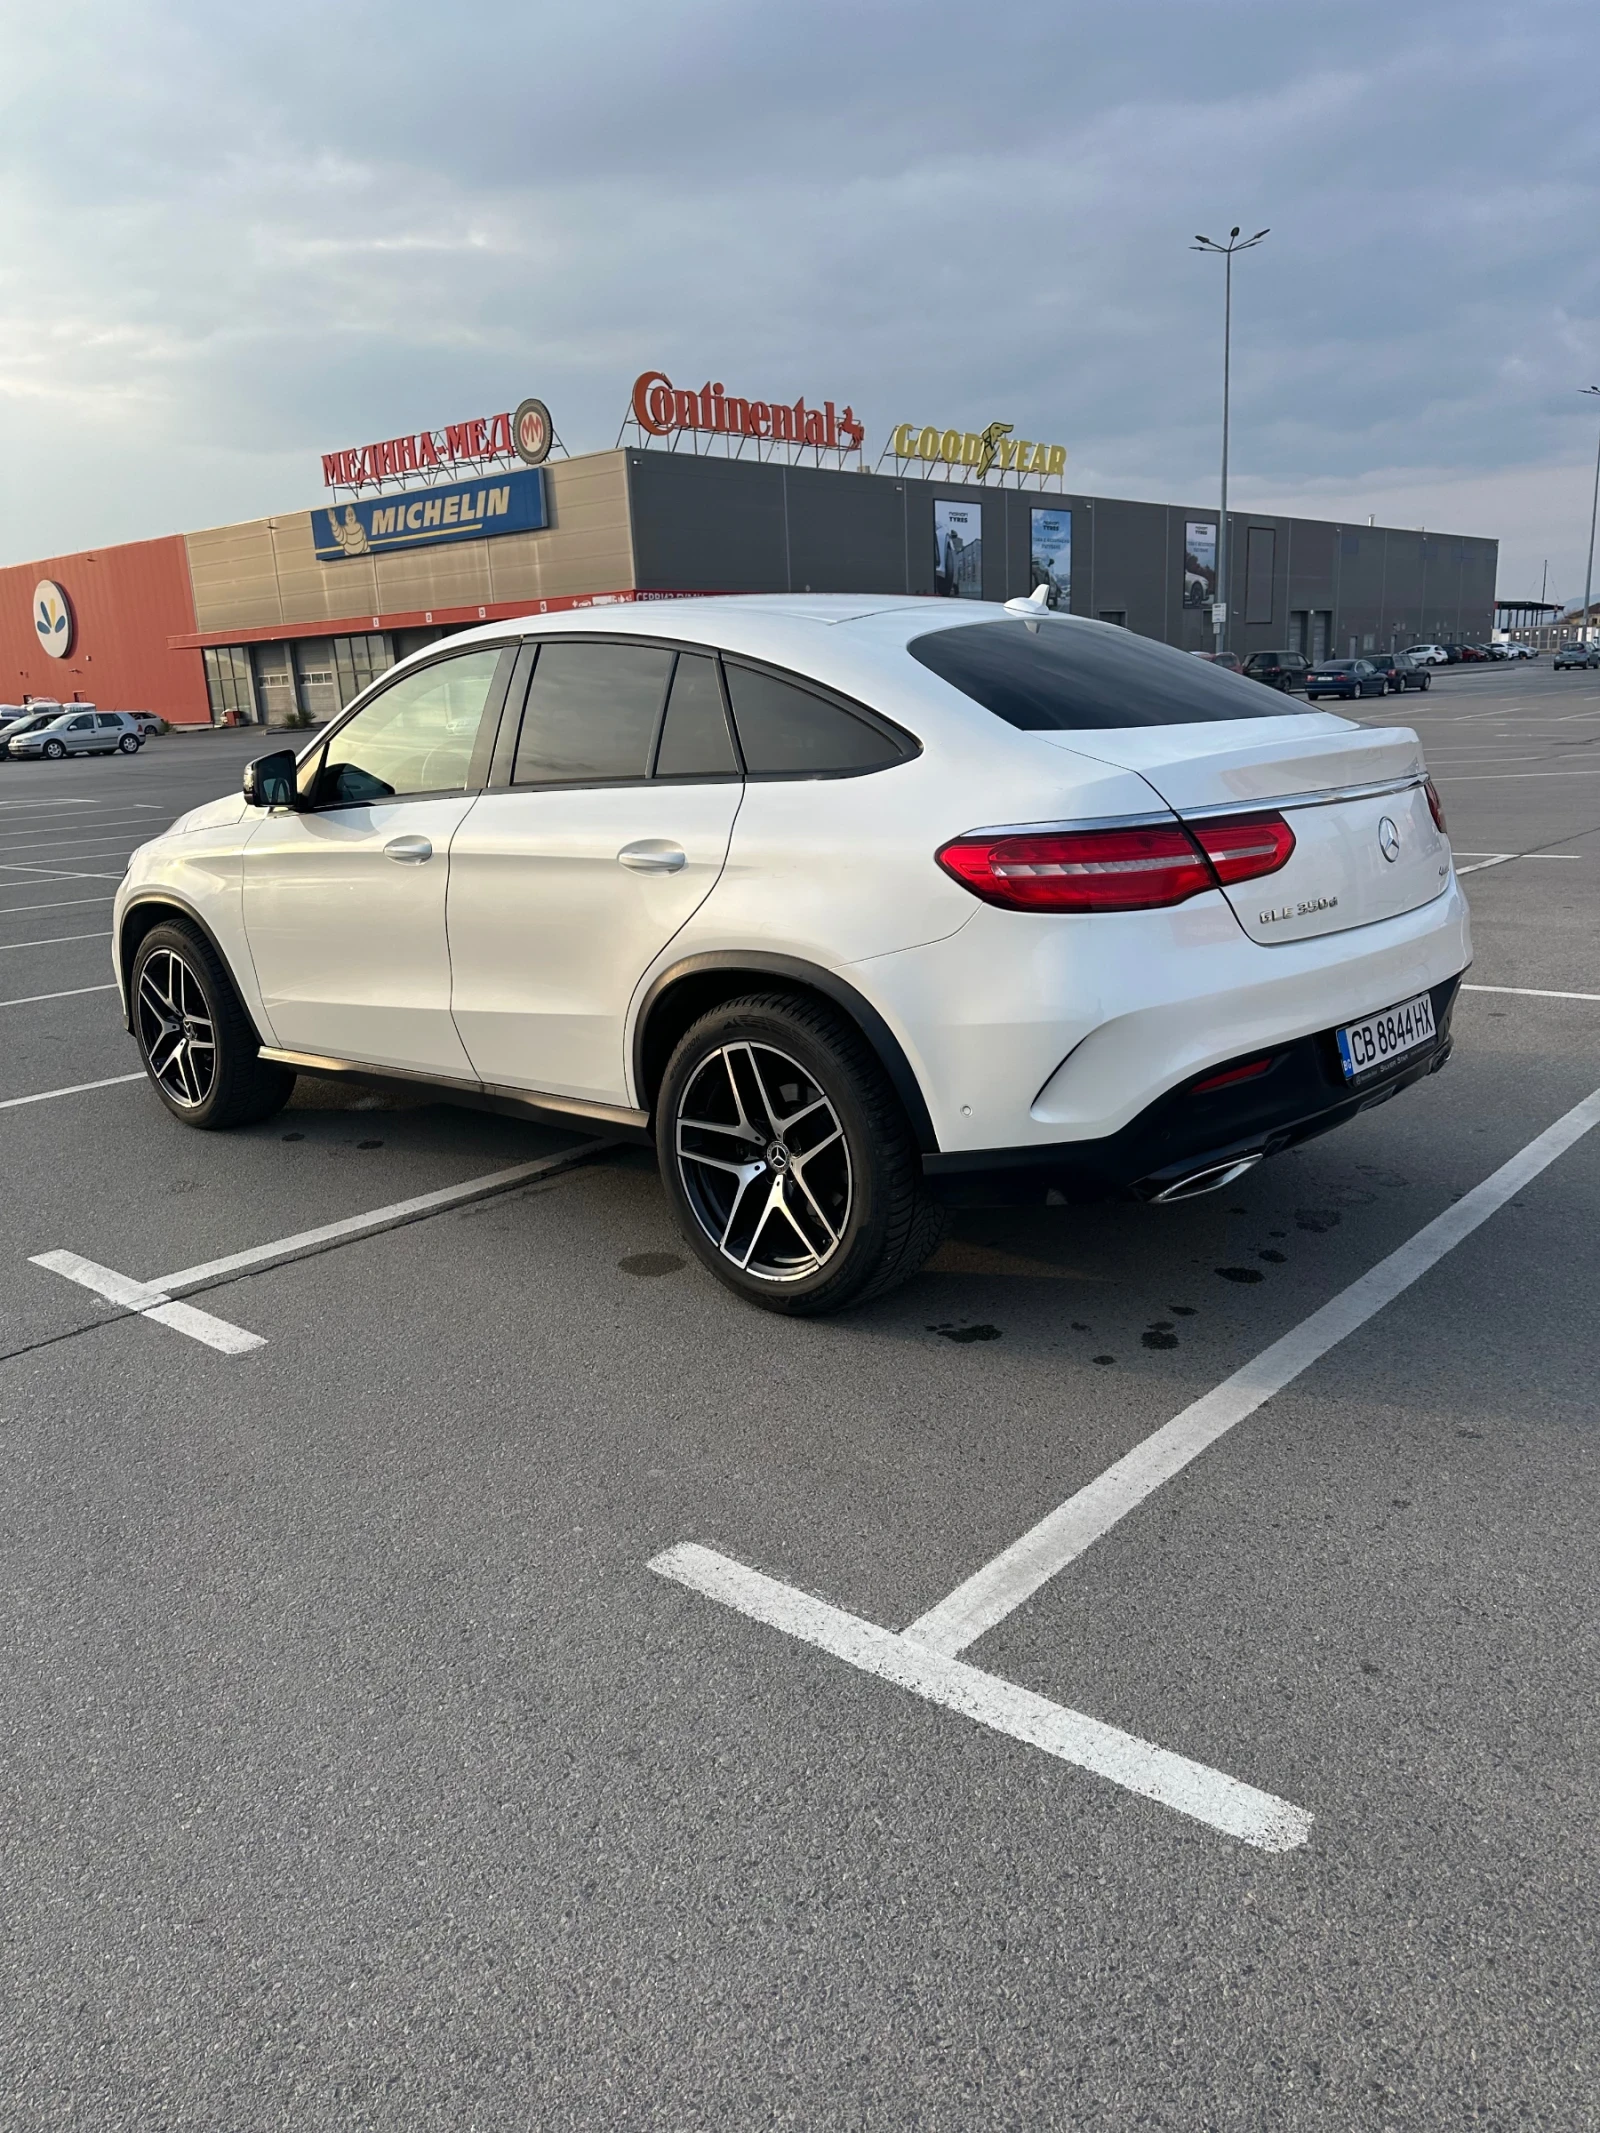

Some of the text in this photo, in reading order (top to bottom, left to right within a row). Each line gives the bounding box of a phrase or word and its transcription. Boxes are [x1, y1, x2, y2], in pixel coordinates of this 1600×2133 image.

[632, 370, 837, 447] Continental
[371, 485, 511, 536] MICHELIN
[1259, 907, 1294, 924] GLE
[1351, 1026, 1376, 1066] CB
[1377, 1008, 1414, 1055] 8844
